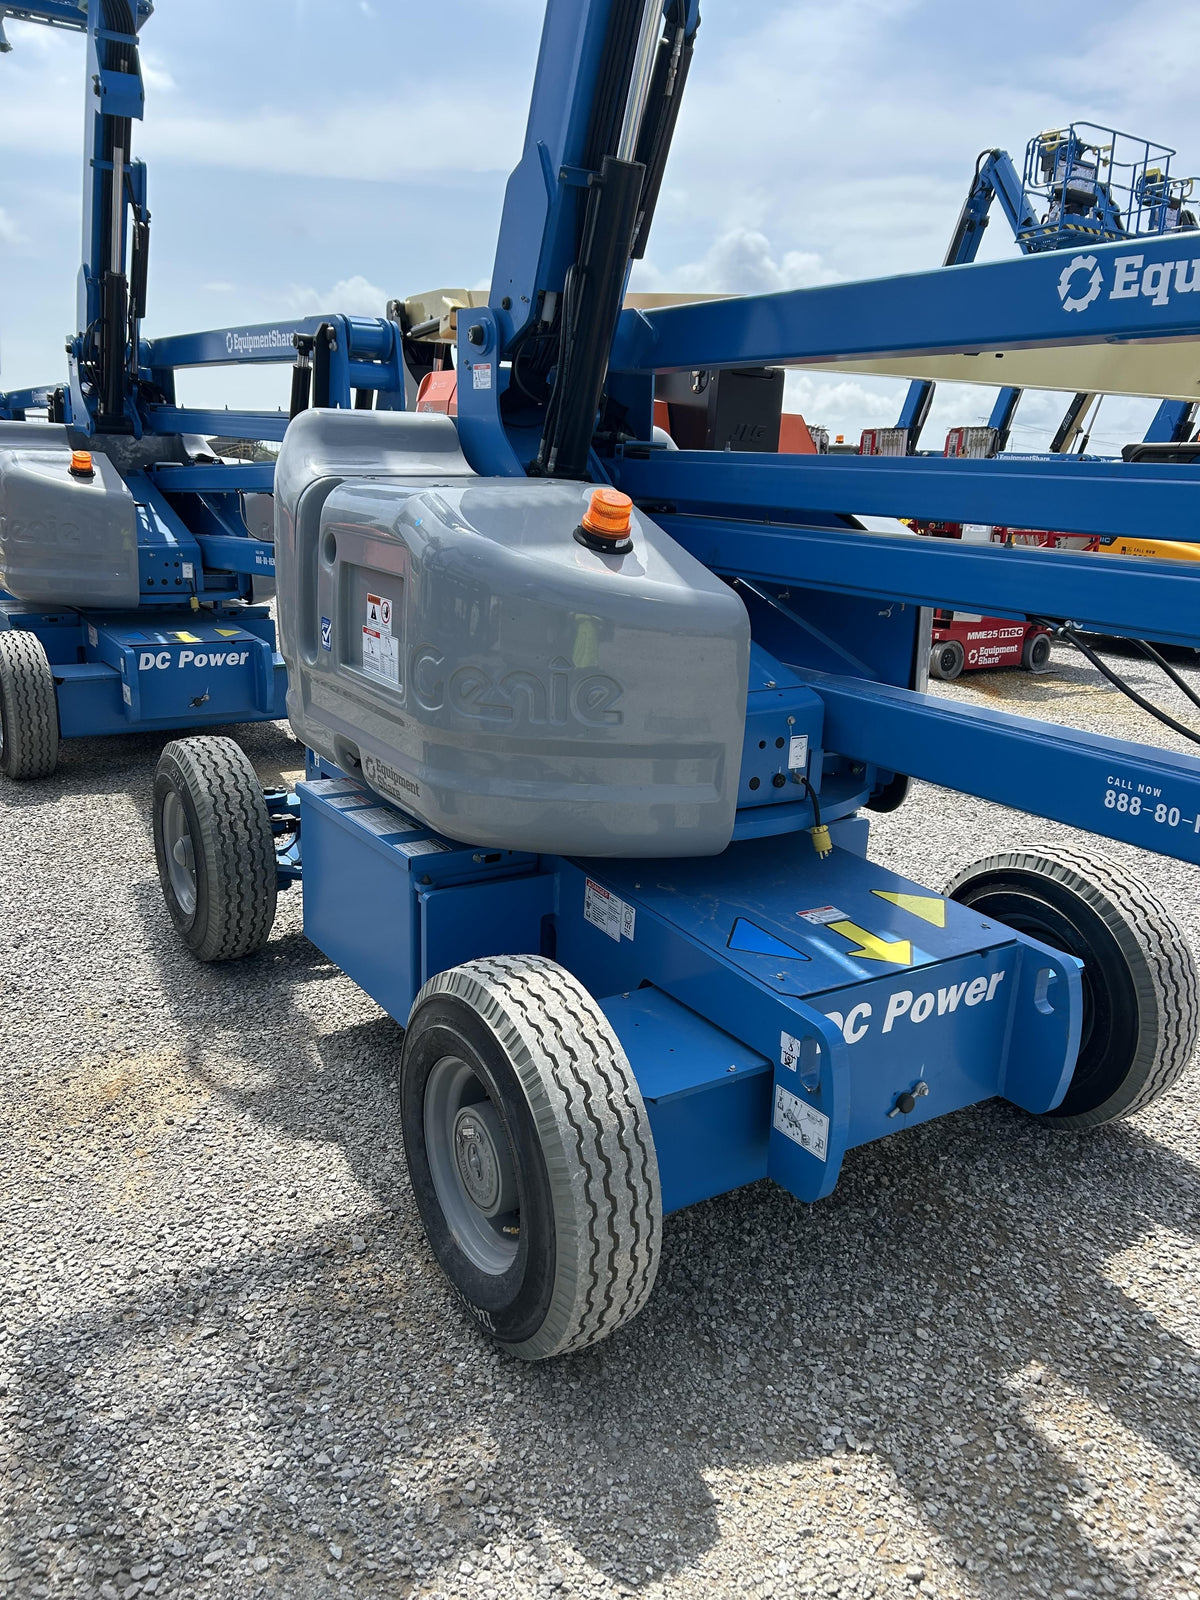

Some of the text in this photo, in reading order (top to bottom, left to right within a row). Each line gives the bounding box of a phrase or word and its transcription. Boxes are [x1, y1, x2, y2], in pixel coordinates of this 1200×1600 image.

[233, 329, 294, 353] EquipmentShare
[967, 627, 1023, 640] MME25 mec
[139, 650, 249, 671] DC Power
[978, 655, 1000, 665] Share
[979, 644, 1018, 656] Equipment
[409, 642, 625, 727] Genie
[376, 757, 420, 798] Equipment
[377, 774, 402, 800] Share
[1107, 776, 1162, 798] CALL NOW
[881, 970, 1006, 1034] Power
